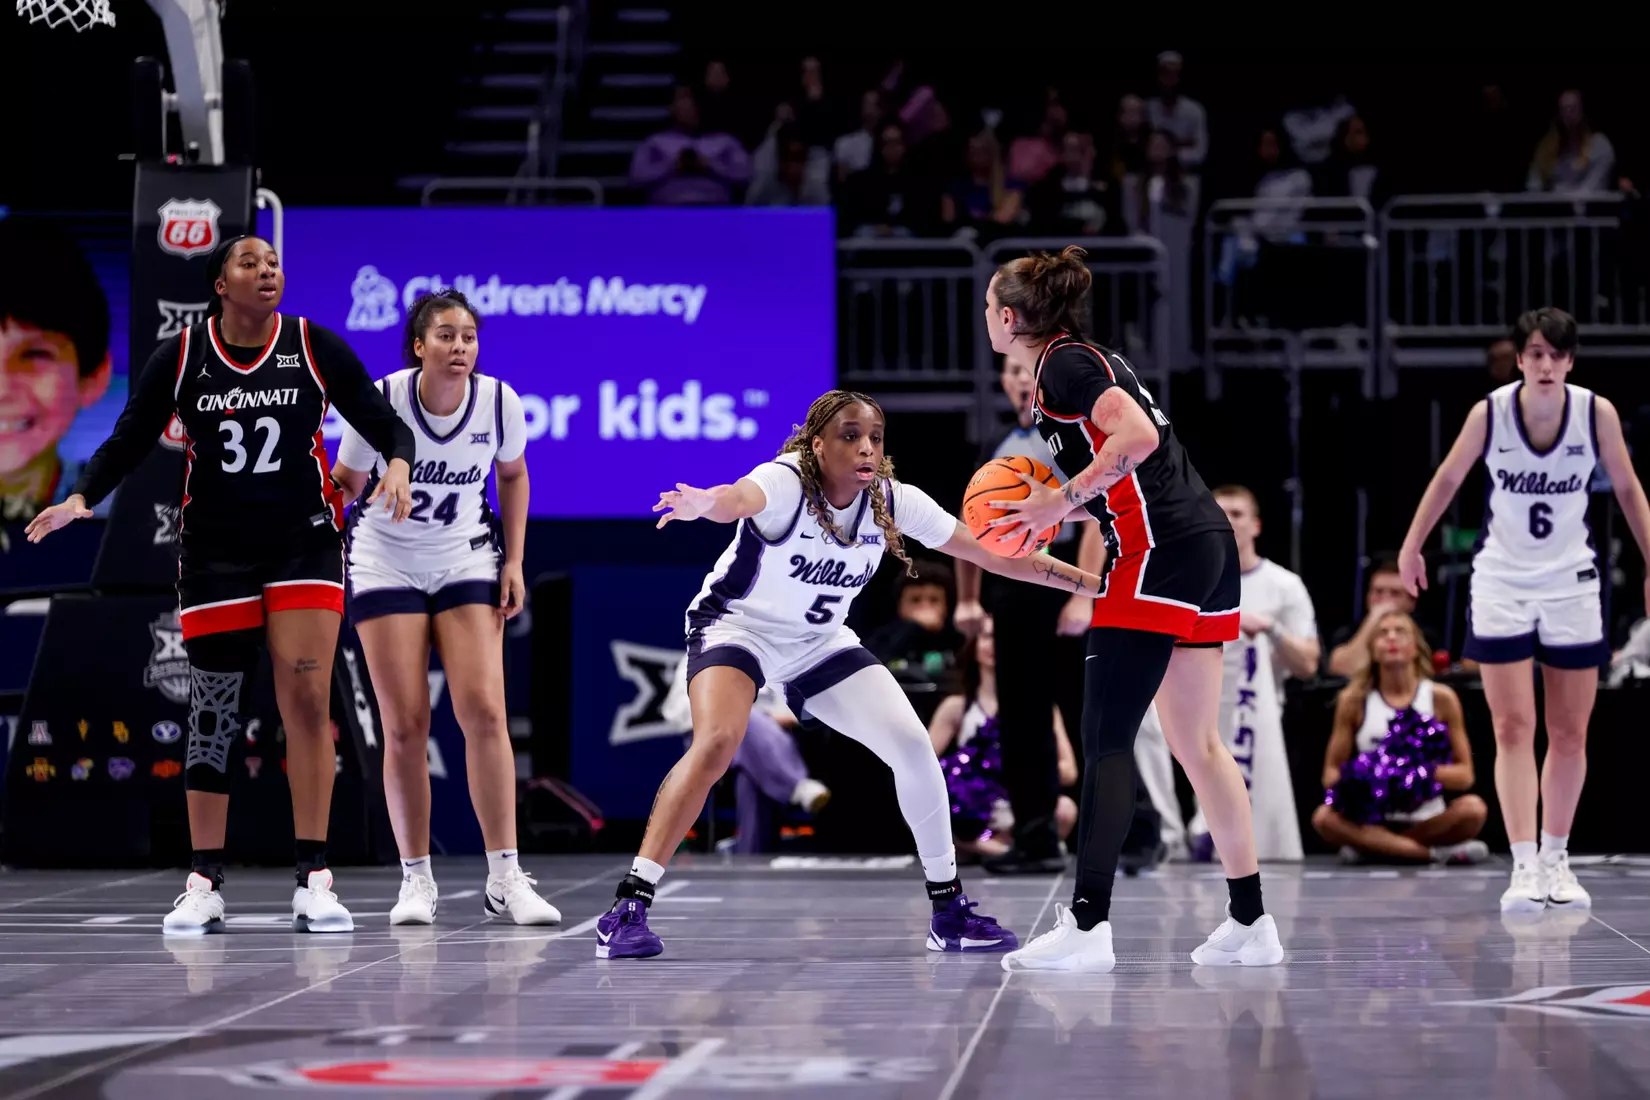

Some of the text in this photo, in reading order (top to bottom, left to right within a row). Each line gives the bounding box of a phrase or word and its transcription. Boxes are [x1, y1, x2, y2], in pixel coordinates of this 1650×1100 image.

[170, 221, 206, 244] 66
[586, 276, 707, 325] Mercy
[197, 387, 299, 412] CINCINNATI
[599, 378, 758, 440] kids.
[218, 416, 282, 474] 32
[412, 459, 481, 486] ildcats
[1497, 469, 1583, 494] Wildcats
[408, 489, 460, 526] 24
[1529, 502, 1554, 540] 6
[804, 593, 844, 625] 5
